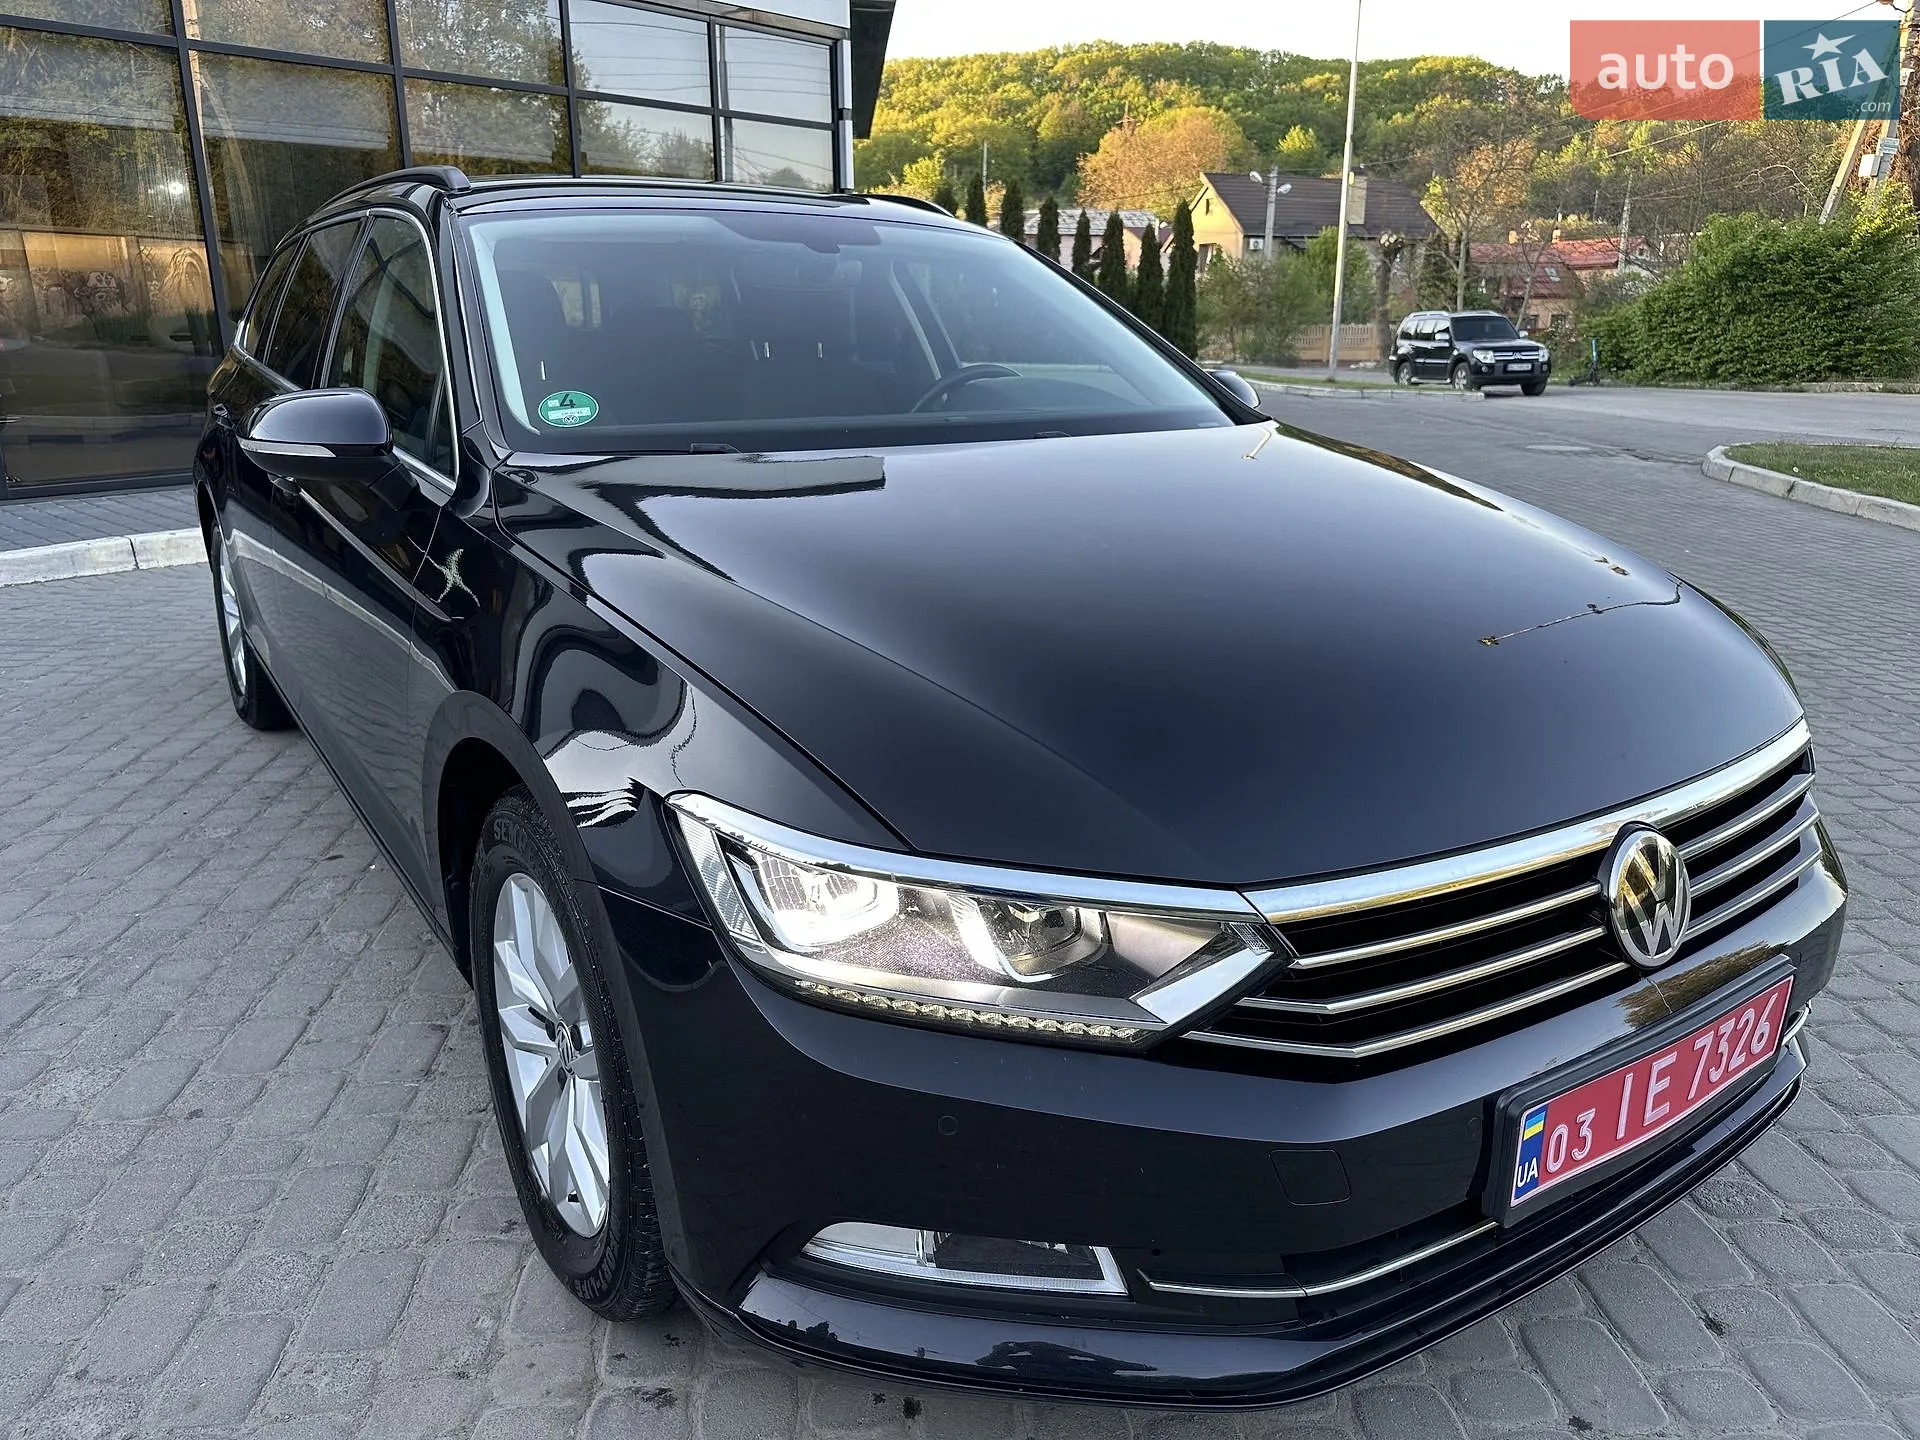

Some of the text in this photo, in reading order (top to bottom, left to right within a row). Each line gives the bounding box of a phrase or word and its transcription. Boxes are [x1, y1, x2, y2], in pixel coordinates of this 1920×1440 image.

[560, 393, 576, 408] 4
[1546, 992, 1779, 1174] 03 IE 7326
[1516, 1164, 1539, 1188] UA
